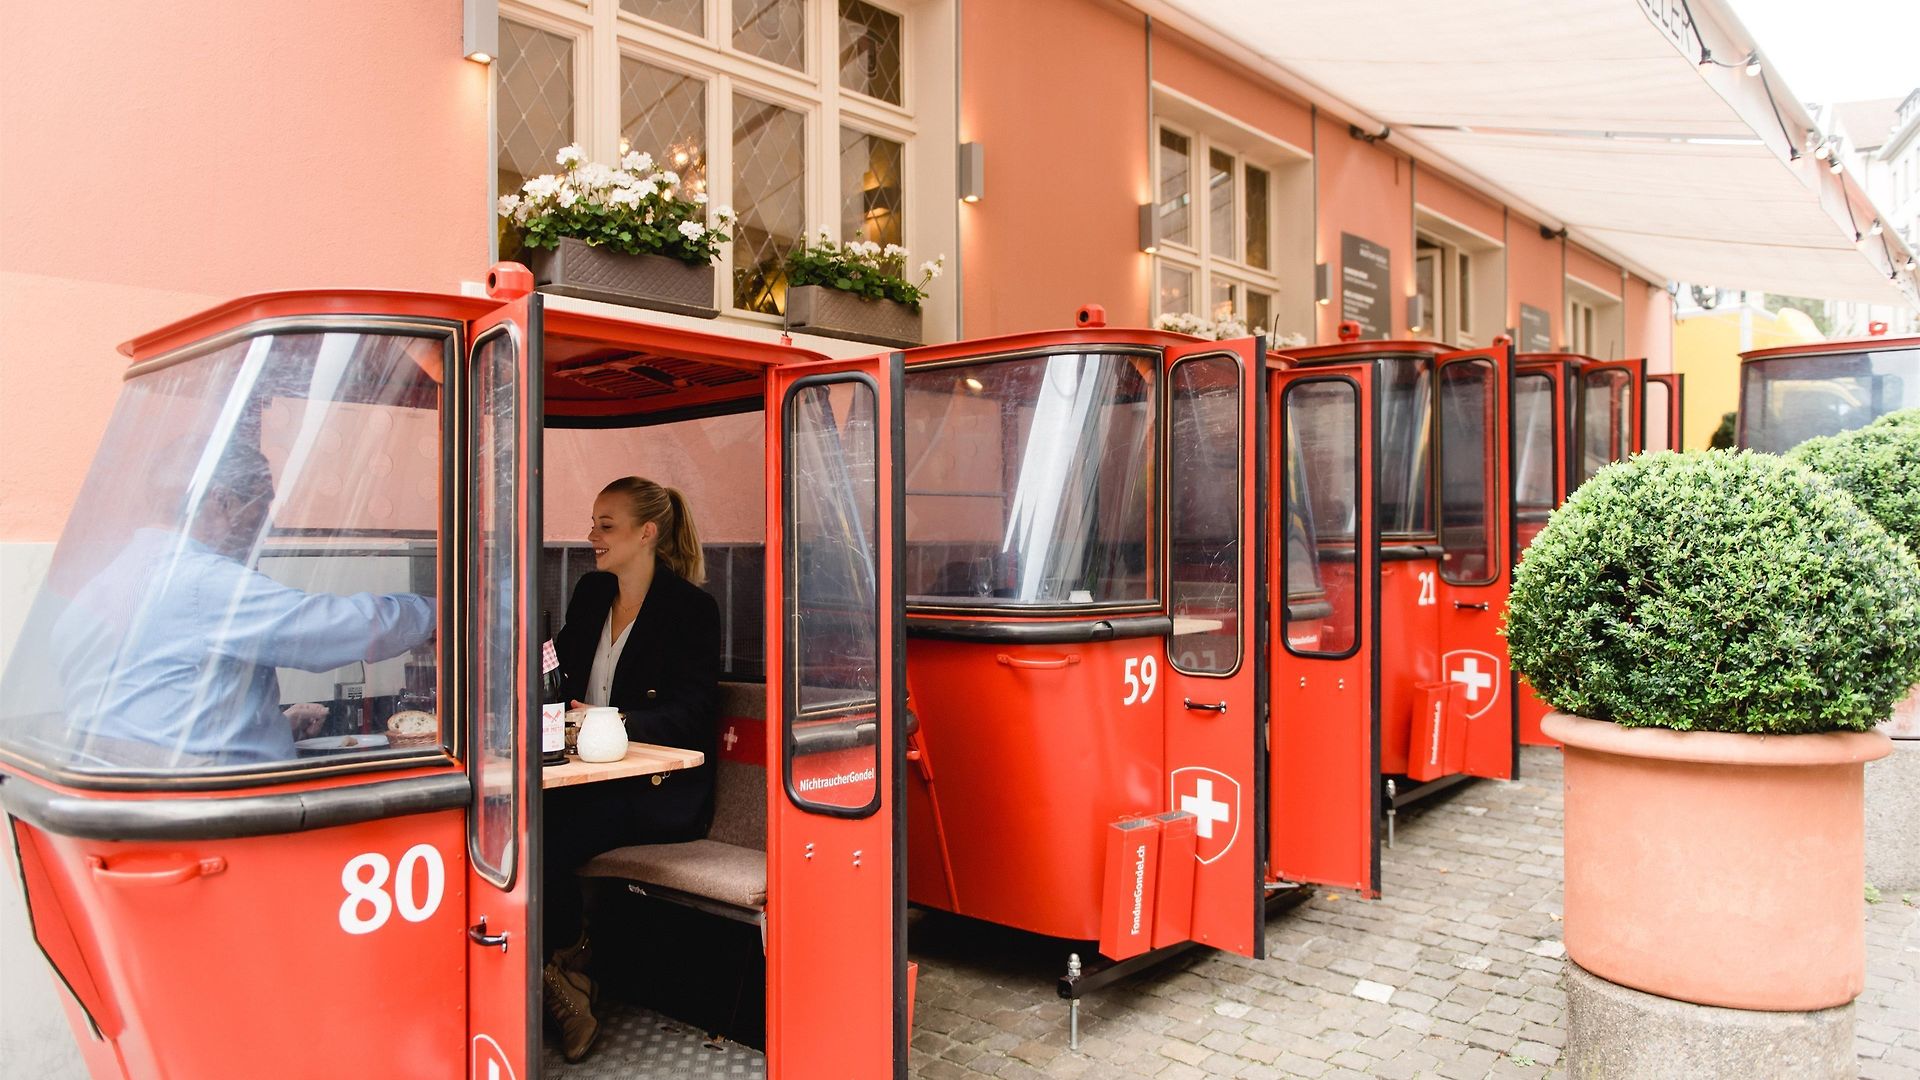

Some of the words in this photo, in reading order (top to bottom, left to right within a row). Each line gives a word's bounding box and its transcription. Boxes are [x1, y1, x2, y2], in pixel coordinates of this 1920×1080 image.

[1418, 571, 1436, 606] 21
[1123, 655, 1157, 706] 59
[800, 767, 875, 791] NichtraucherGondel
[338, 843, 445, 935] 80
[1131, 845, 1145, 935] FondueGondel.ch
